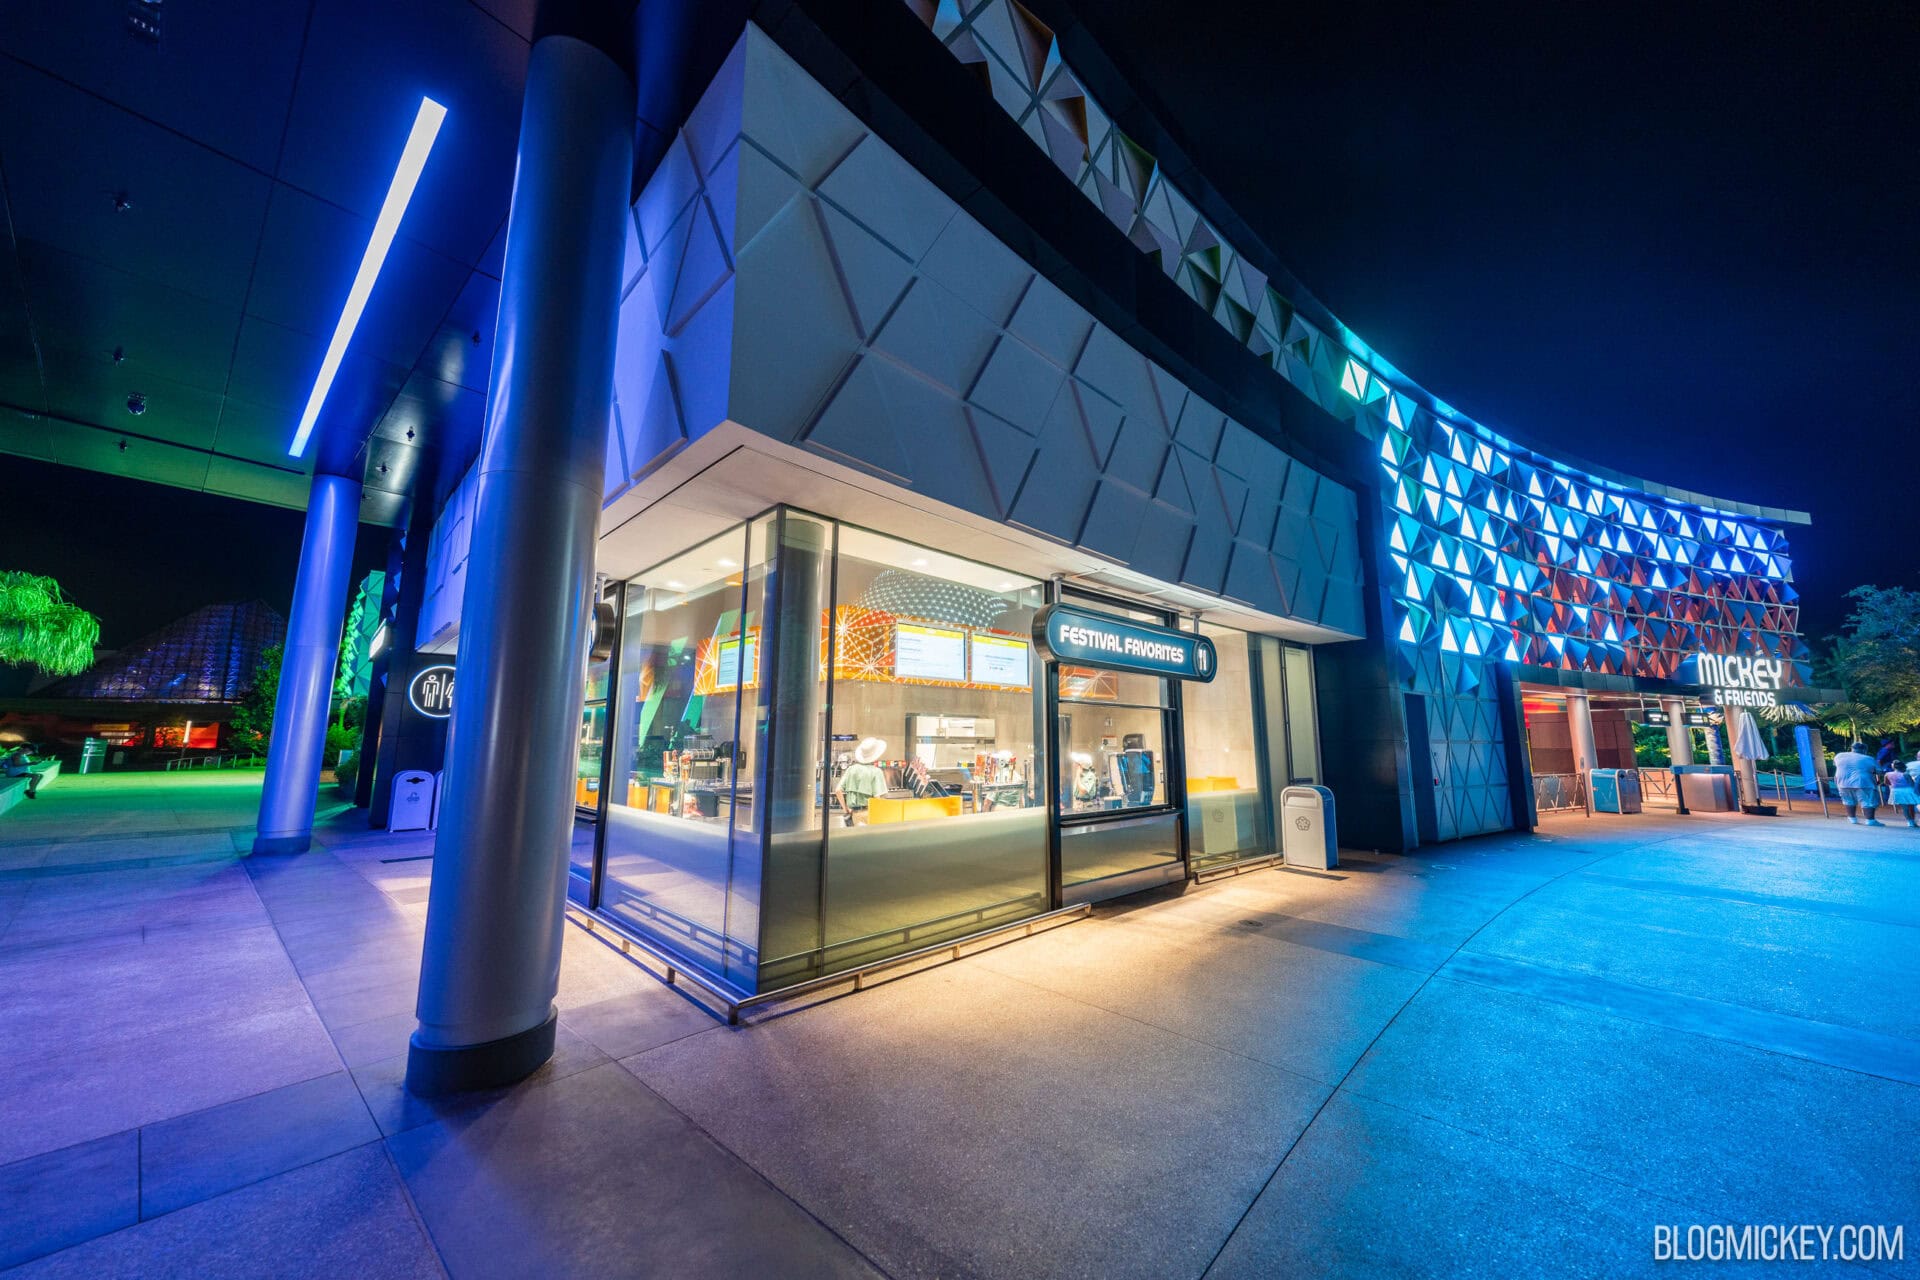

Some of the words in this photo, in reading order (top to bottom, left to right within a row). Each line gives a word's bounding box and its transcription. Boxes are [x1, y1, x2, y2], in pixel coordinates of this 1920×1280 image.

[1060, 624, 1122, 653] FESTIVAL
[1124, 637, 1184, 664] FAVORITES
[1697, 652, 1782, 689] MICKEY
[1714, 689, 1722, 705] &
[1725, 690, 1776, 707] FRIENDS
